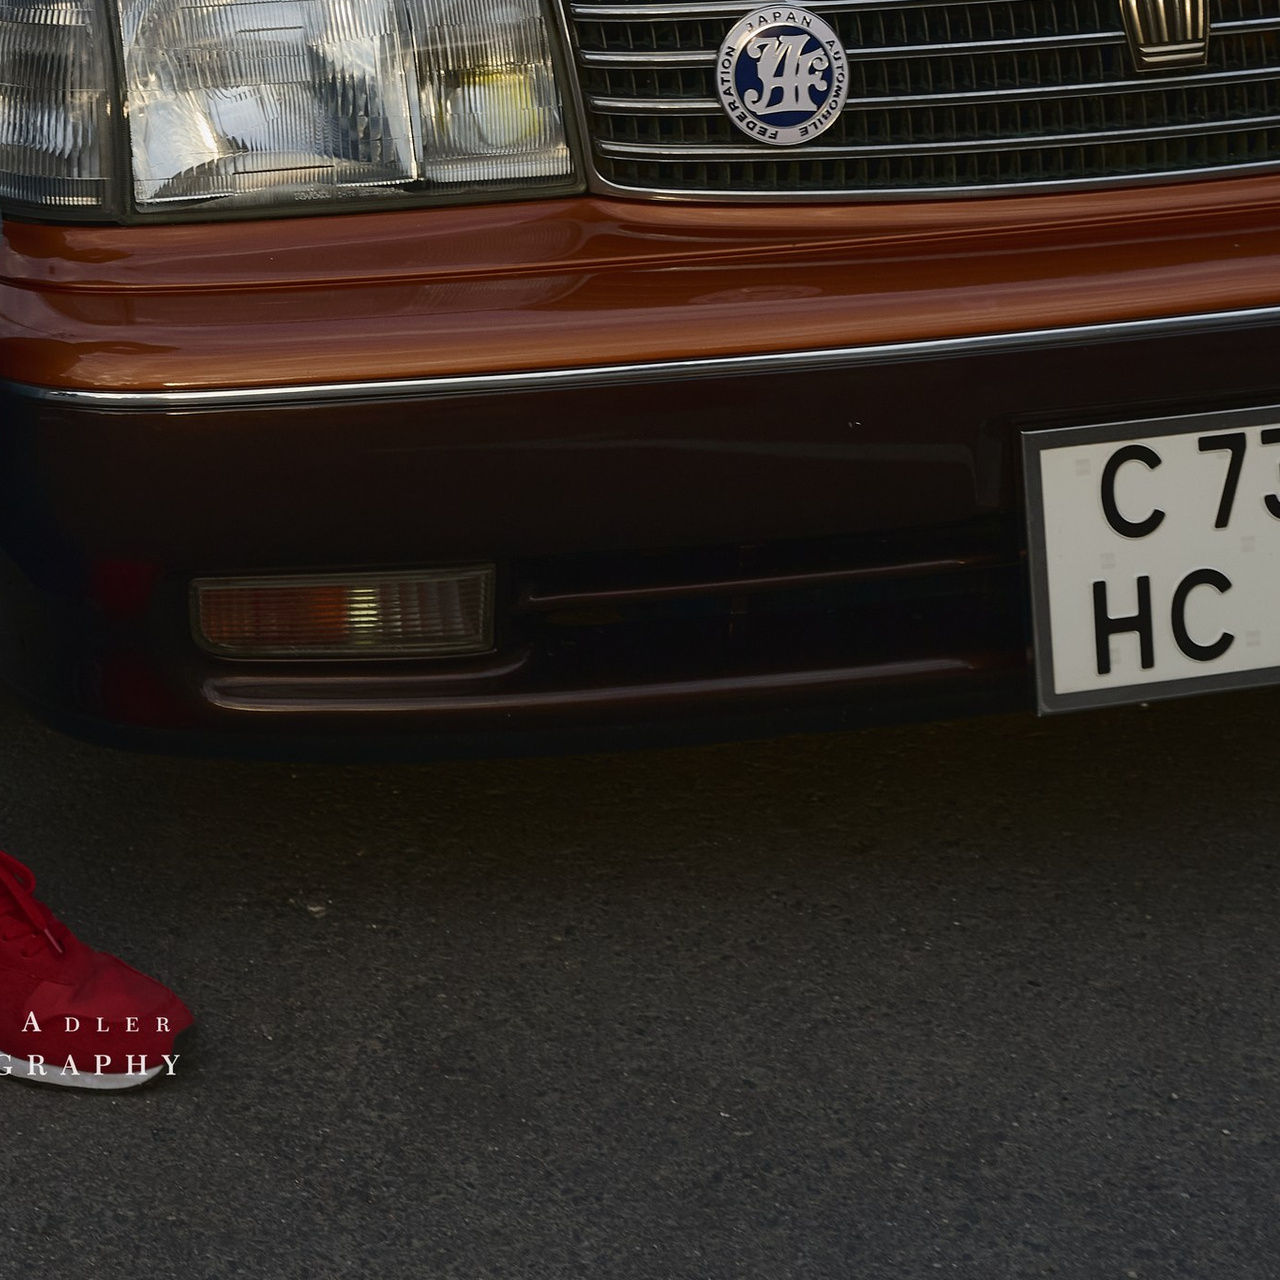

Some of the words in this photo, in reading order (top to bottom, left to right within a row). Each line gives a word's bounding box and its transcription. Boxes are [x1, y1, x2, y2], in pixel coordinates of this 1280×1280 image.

[745, 11, 813, 33] JAPAN
[721, 45, 779, 140] FEDERATION
[799, 39, 845, 137] AUTOMOBILE
